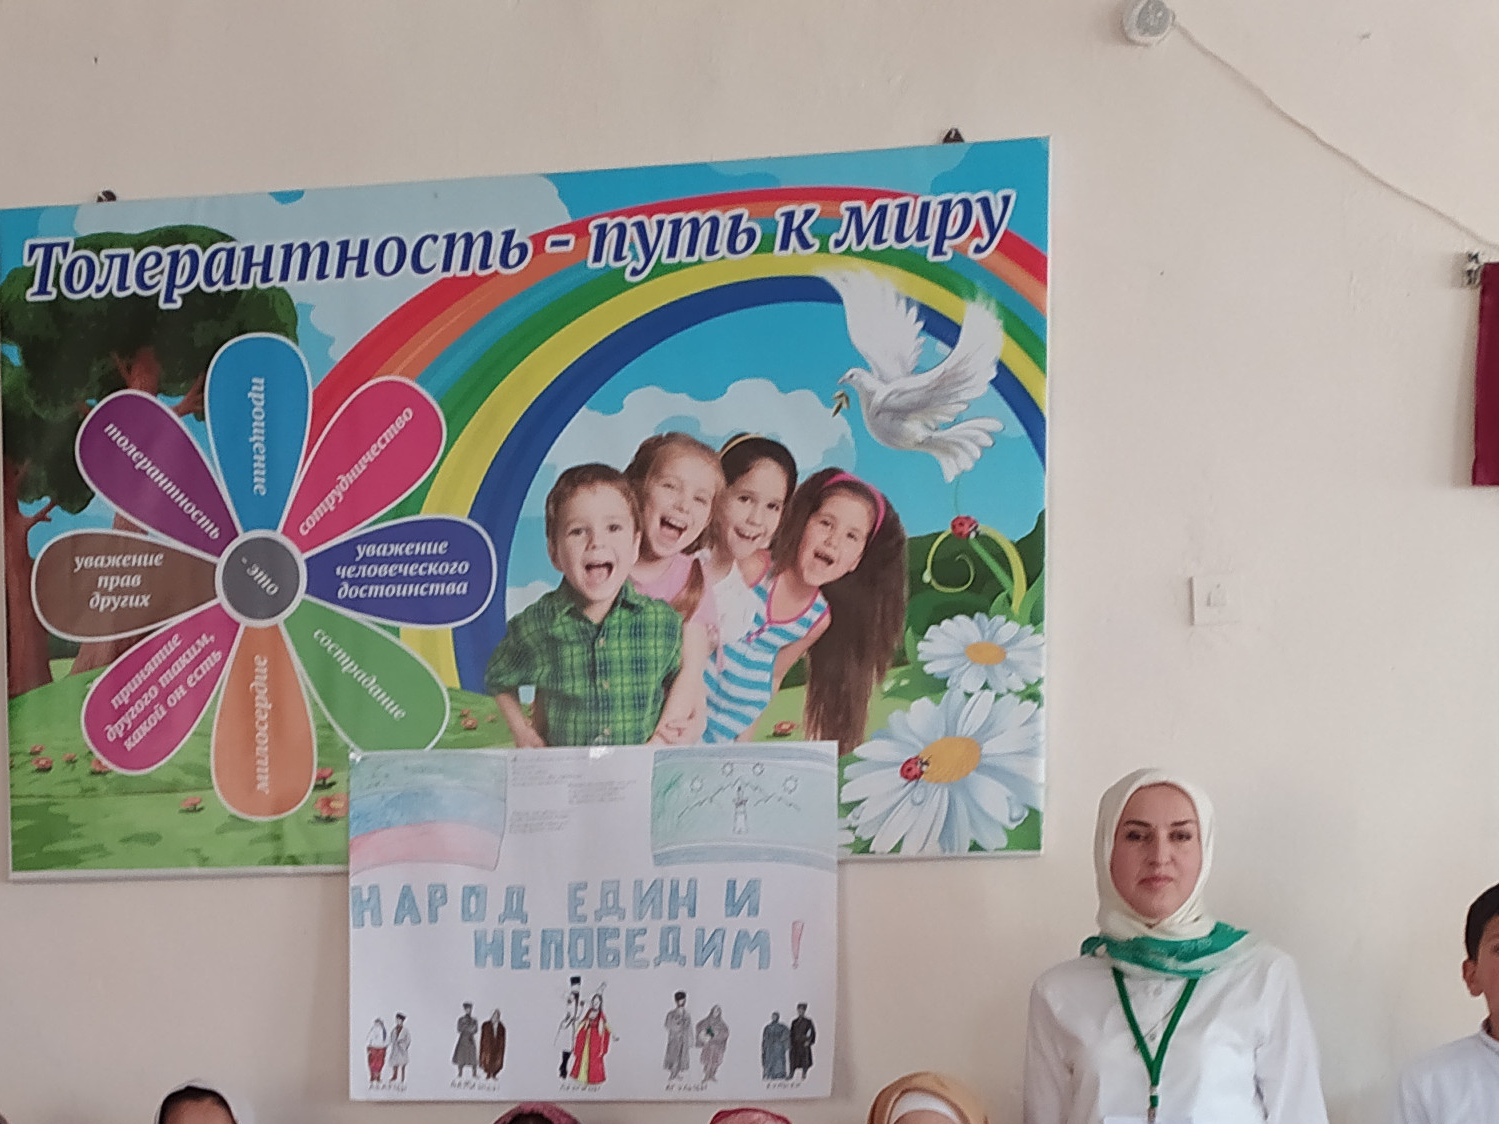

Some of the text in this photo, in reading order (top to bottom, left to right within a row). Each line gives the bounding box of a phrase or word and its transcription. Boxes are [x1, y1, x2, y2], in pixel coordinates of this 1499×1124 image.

[26, 227, 530, 304] Толерантность
[591, 209, 757, 279] путь
[777, 203, 816, 253] к
[835, 191, 1013, 259] миру
[248, 377, 267, 496] прощение
[104, 423, 220, 540] толерантность
[300, 407, 413, 536] сотрудничество
[73, 552, 164, 573] уважение
[335, 560, 470, 580] человеческого
[355, 540, 449, 561] уважение
[89, 591, 151, 612] других
[97, 573, 142, 592] прав
[246, 563, 279, 596] это
[337, 581, 469, 600] достоинства
[111, 633, 182, 710] принятие
[313, 628, 406, 721] сострадание
[104, 685, 159, 742] другого
[124, 650, 222, 751] какой он есть
[250, 654, 273, 795] милосердие
[351, 877, 763, 928] НАРОД ЕДИН И
